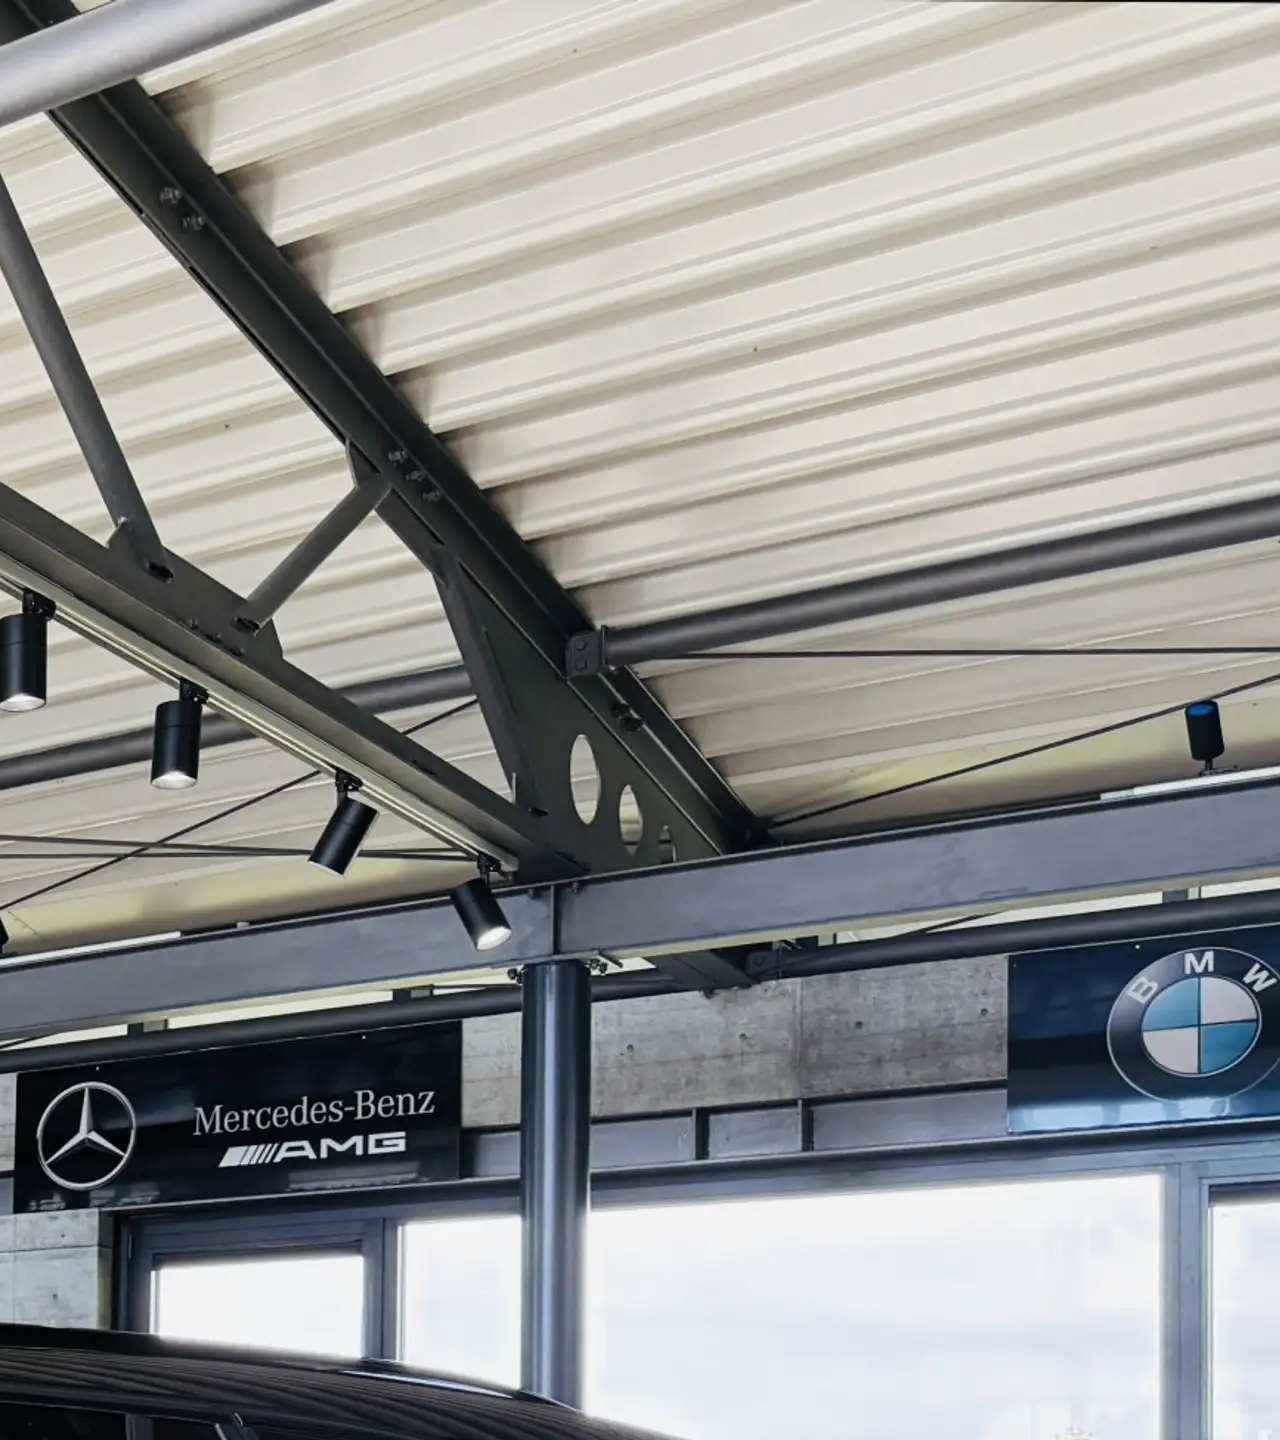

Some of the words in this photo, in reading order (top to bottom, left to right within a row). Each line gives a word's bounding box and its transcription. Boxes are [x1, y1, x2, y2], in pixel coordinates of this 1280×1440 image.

[1126, 950, 1277, 1005] BMW
[192, 1089, 436, 1136] Mercedes-Benz
[273, 1131, 407, 1164] AMG
